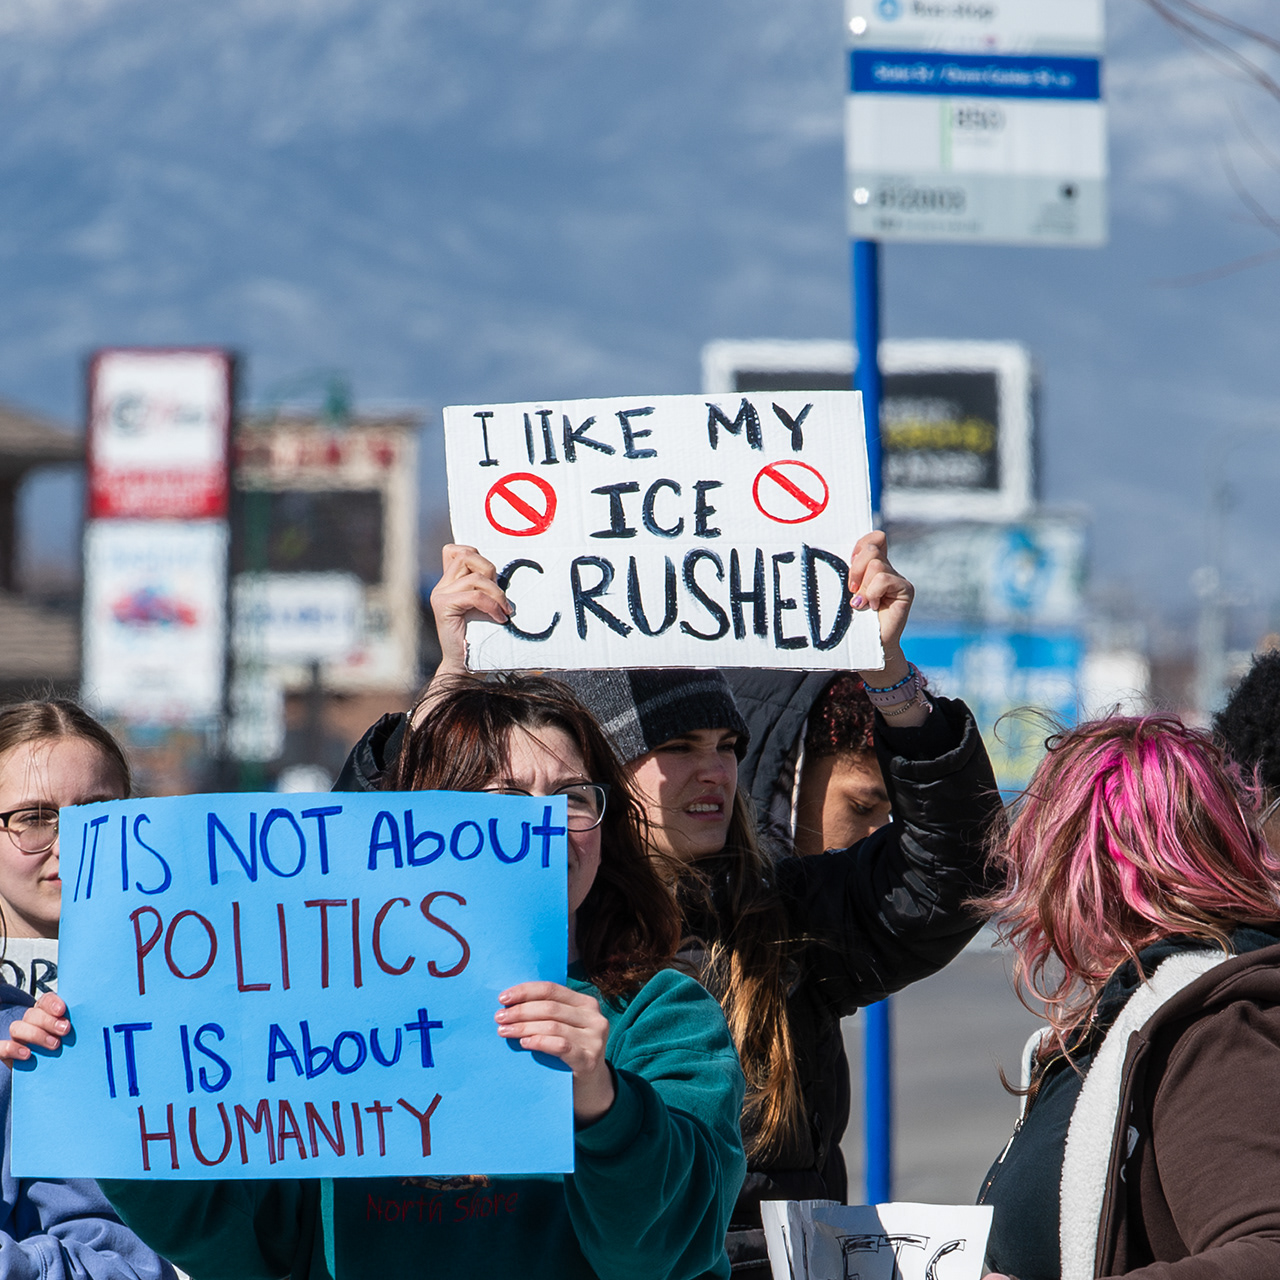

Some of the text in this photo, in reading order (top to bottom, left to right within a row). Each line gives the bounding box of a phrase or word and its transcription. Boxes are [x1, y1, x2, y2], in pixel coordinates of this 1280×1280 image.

[473, 411, 499, 467] I
[705, 397, 814, 452] MY
[589, 477, 724, 540] ICE
[496, 542, 854, 652] CRUSHED
[73, 806, 566, 901] IT IS NOT About
[130, 891, 471, 996] POLITICS
[102, 1008, 443, 1099] IT IS About
[137, 1093, 443, 1171] HUMANITY
[367, 1189, 519, 1224] North Shore
